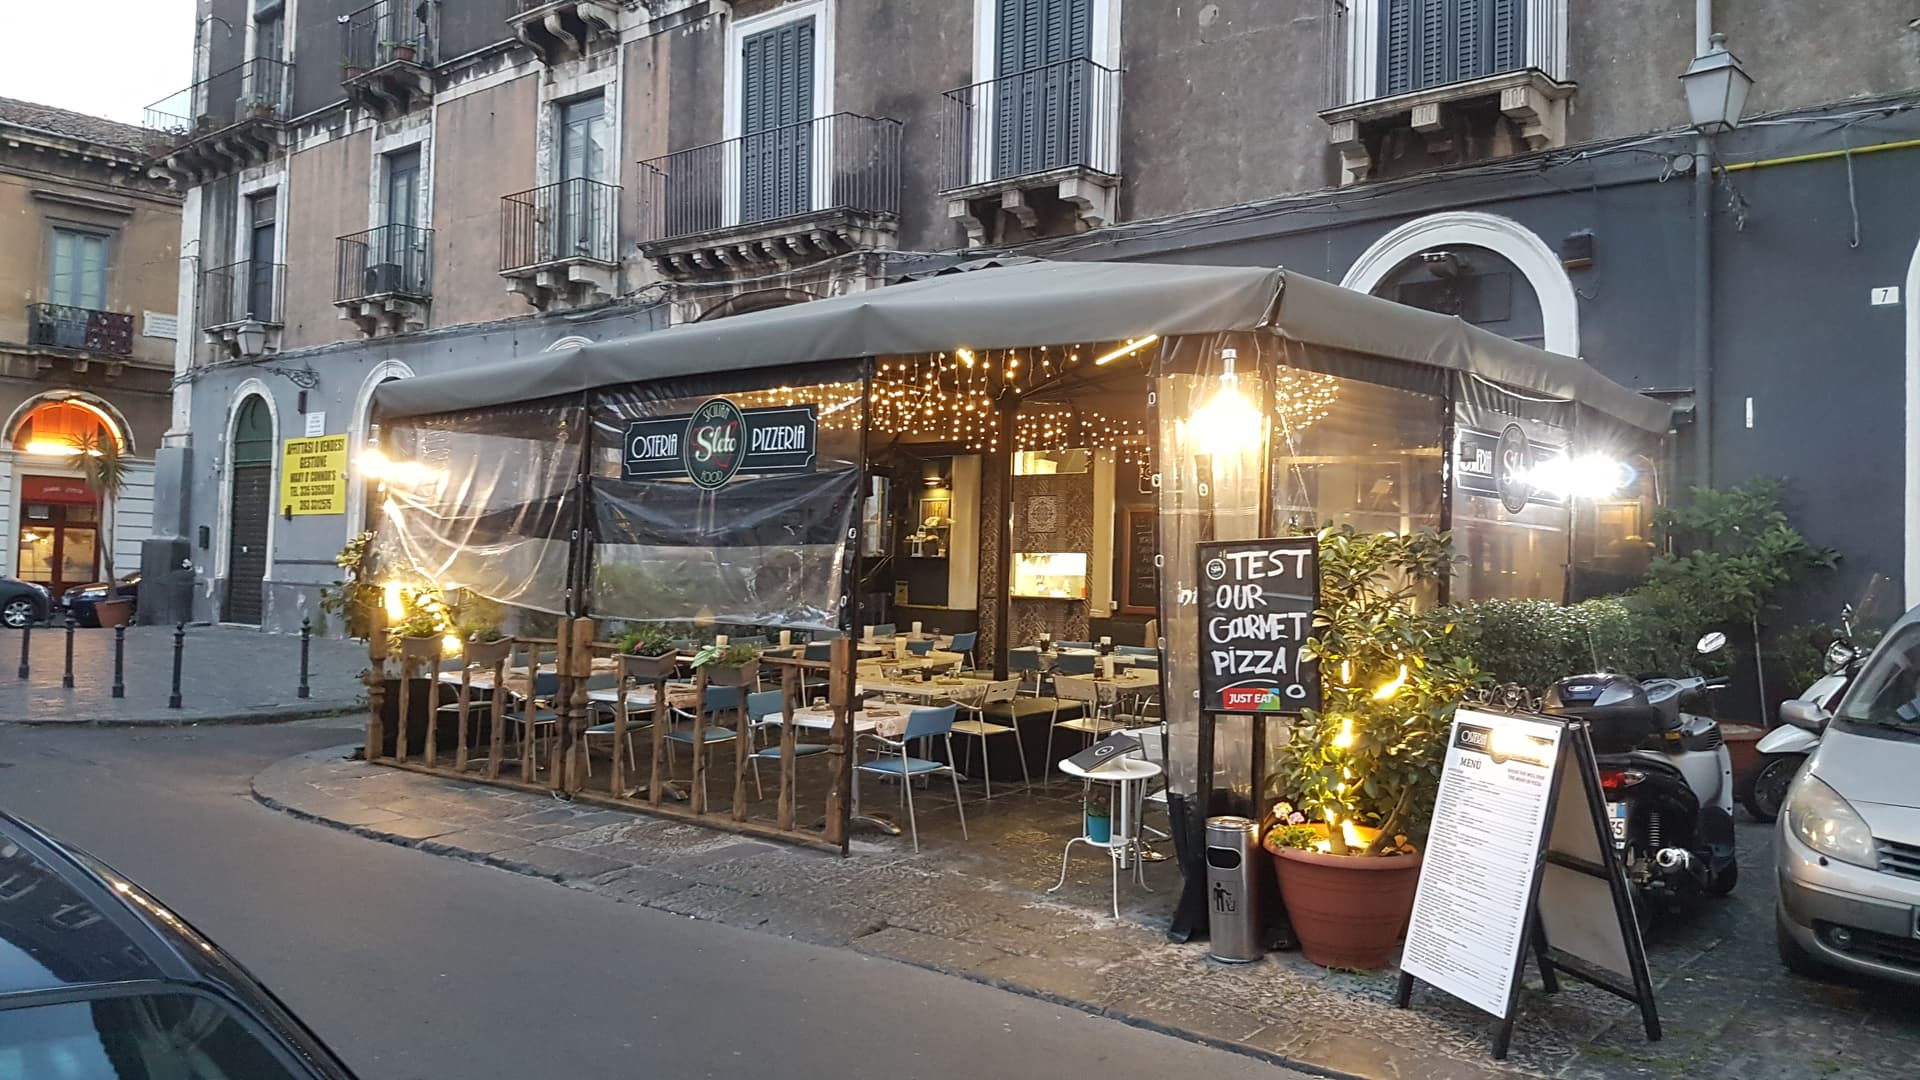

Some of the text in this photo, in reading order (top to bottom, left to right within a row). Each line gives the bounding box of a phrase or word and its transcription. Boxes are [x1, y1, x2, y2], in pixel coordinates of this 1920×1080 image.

[1881, 289, 1889, 303] 7
[287, 441, 314, 455] AFFITTASI
[320, 438, 345, 452] VENDESI
[631, 433, 678, 458] OSTERIA
[751, 425, 805, 451] PIZZERIA
[299, 455, 327, 469] GESTIONE
[701, 470, 724, 482] FOOD
[1226, 549, 1312, 580] TEST
[1216, 584, 1267, 610] OUR
[1208, 612, 1307, 643] GOURMET
[1229, 692, 1275, 704] JUST EAT
